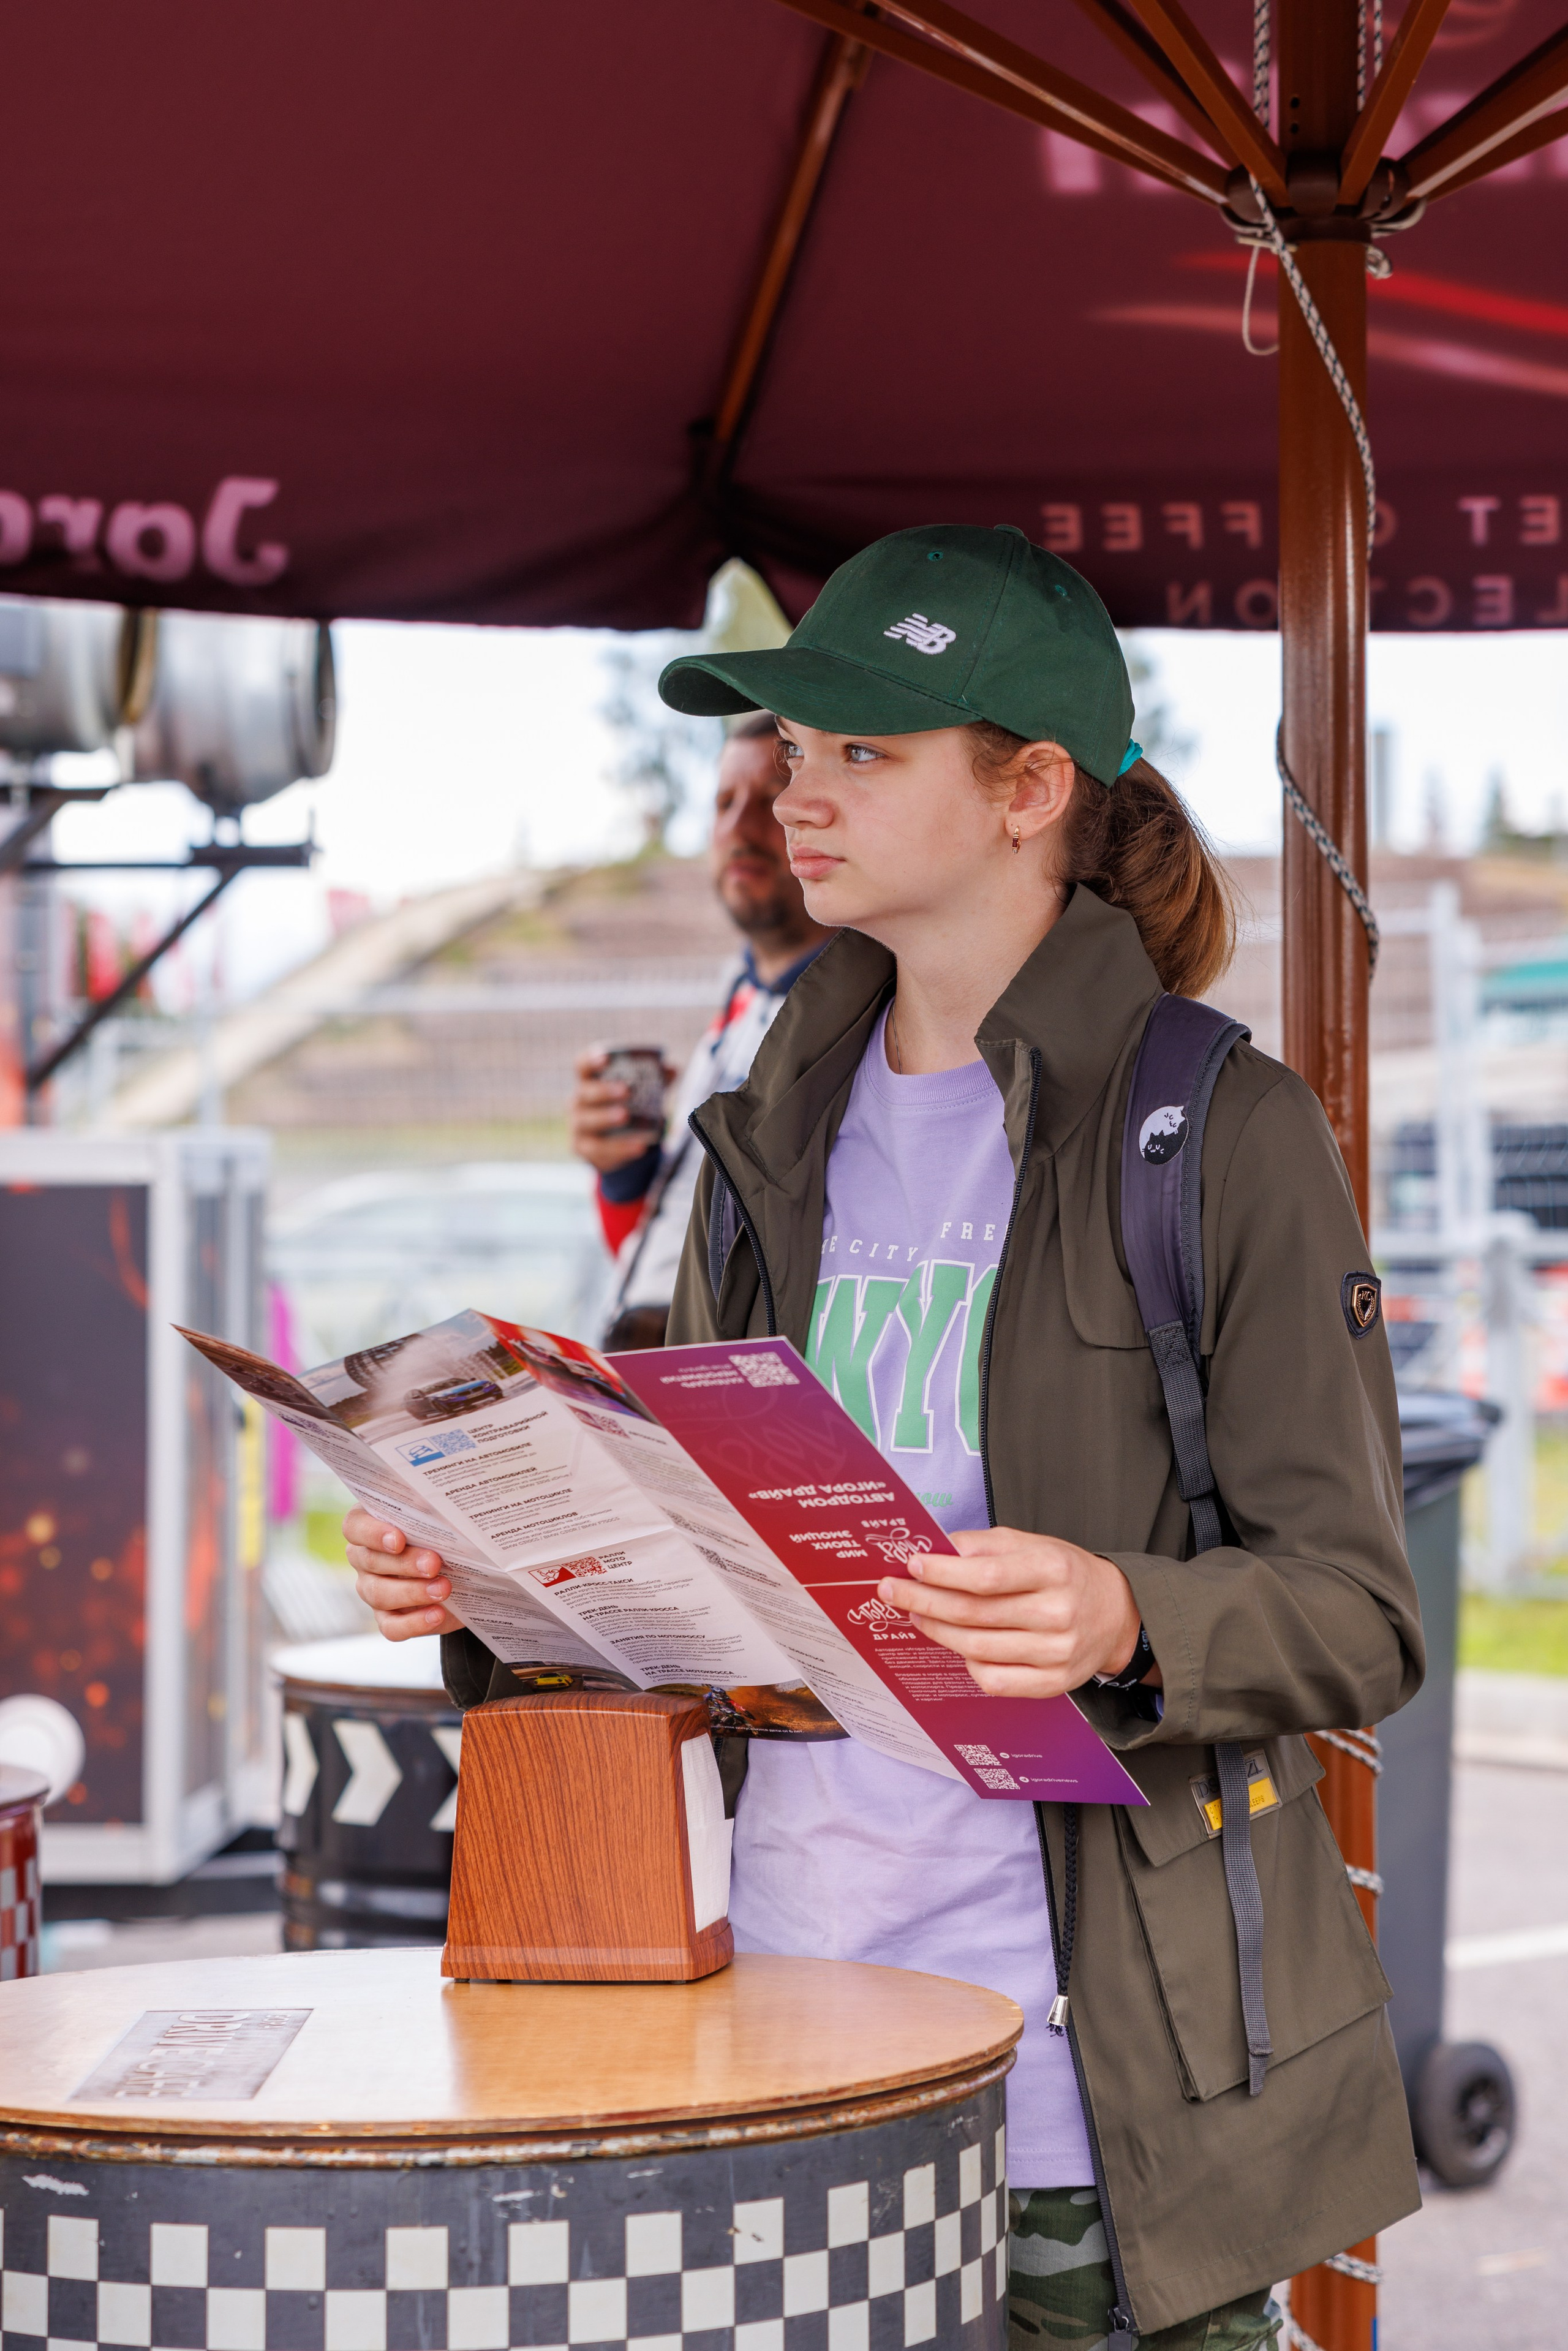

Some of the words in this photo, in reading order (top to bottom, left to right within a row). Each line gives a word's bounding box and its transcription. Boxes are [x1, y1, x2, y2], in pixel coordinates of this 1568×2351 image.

[849, 1239, 918, 1262] CITY
[940, 1221, 1009, 1241] FRE
[423, 1461, 464, 1476] ТРЕНИНГИ
[478, 1442, 532, 1459] АВТОМОБИЛЕ
[444, 1484, 477, 1496] АРЕНДА
[478, 1466, 537, 1485] АВТОМОБИЛЕЙ
[818, 1481, 886, 1494] «ИГОРА
[748, 1484, 817, 1500] ДРАЙВ»
[469, 1505, 510, 1519] ТРЕНИНГИ
[523, 1488, 573, 1503] МОТОЦИКЛЕ
[797, 1492, 895, 1508] АВТОДРОМ
[489, 1527, 522, 1539] АРЕНДА
[523, 1512, 578, 1528] МОТОЦИКЛОВ
[861, 1518, 907, 1529] ДРАЙВ
[789, 1530, 853, 1543] ЭМОЦИЙ
[811, 1539, 861, 1550] ТВОИХ
[836, 1549, 868, 1558] МИР
[554, 1579, 634, 1595] РАЛЛИ-КРОСС-ТАКСИ
[578, 1606, 619, 1615] ТРЕК-ДЕНЬ
[609, 1635, 644, 1643] ЗАНЯТИЯ
[873, 1632, 916, 1640] ДРАЙВ
